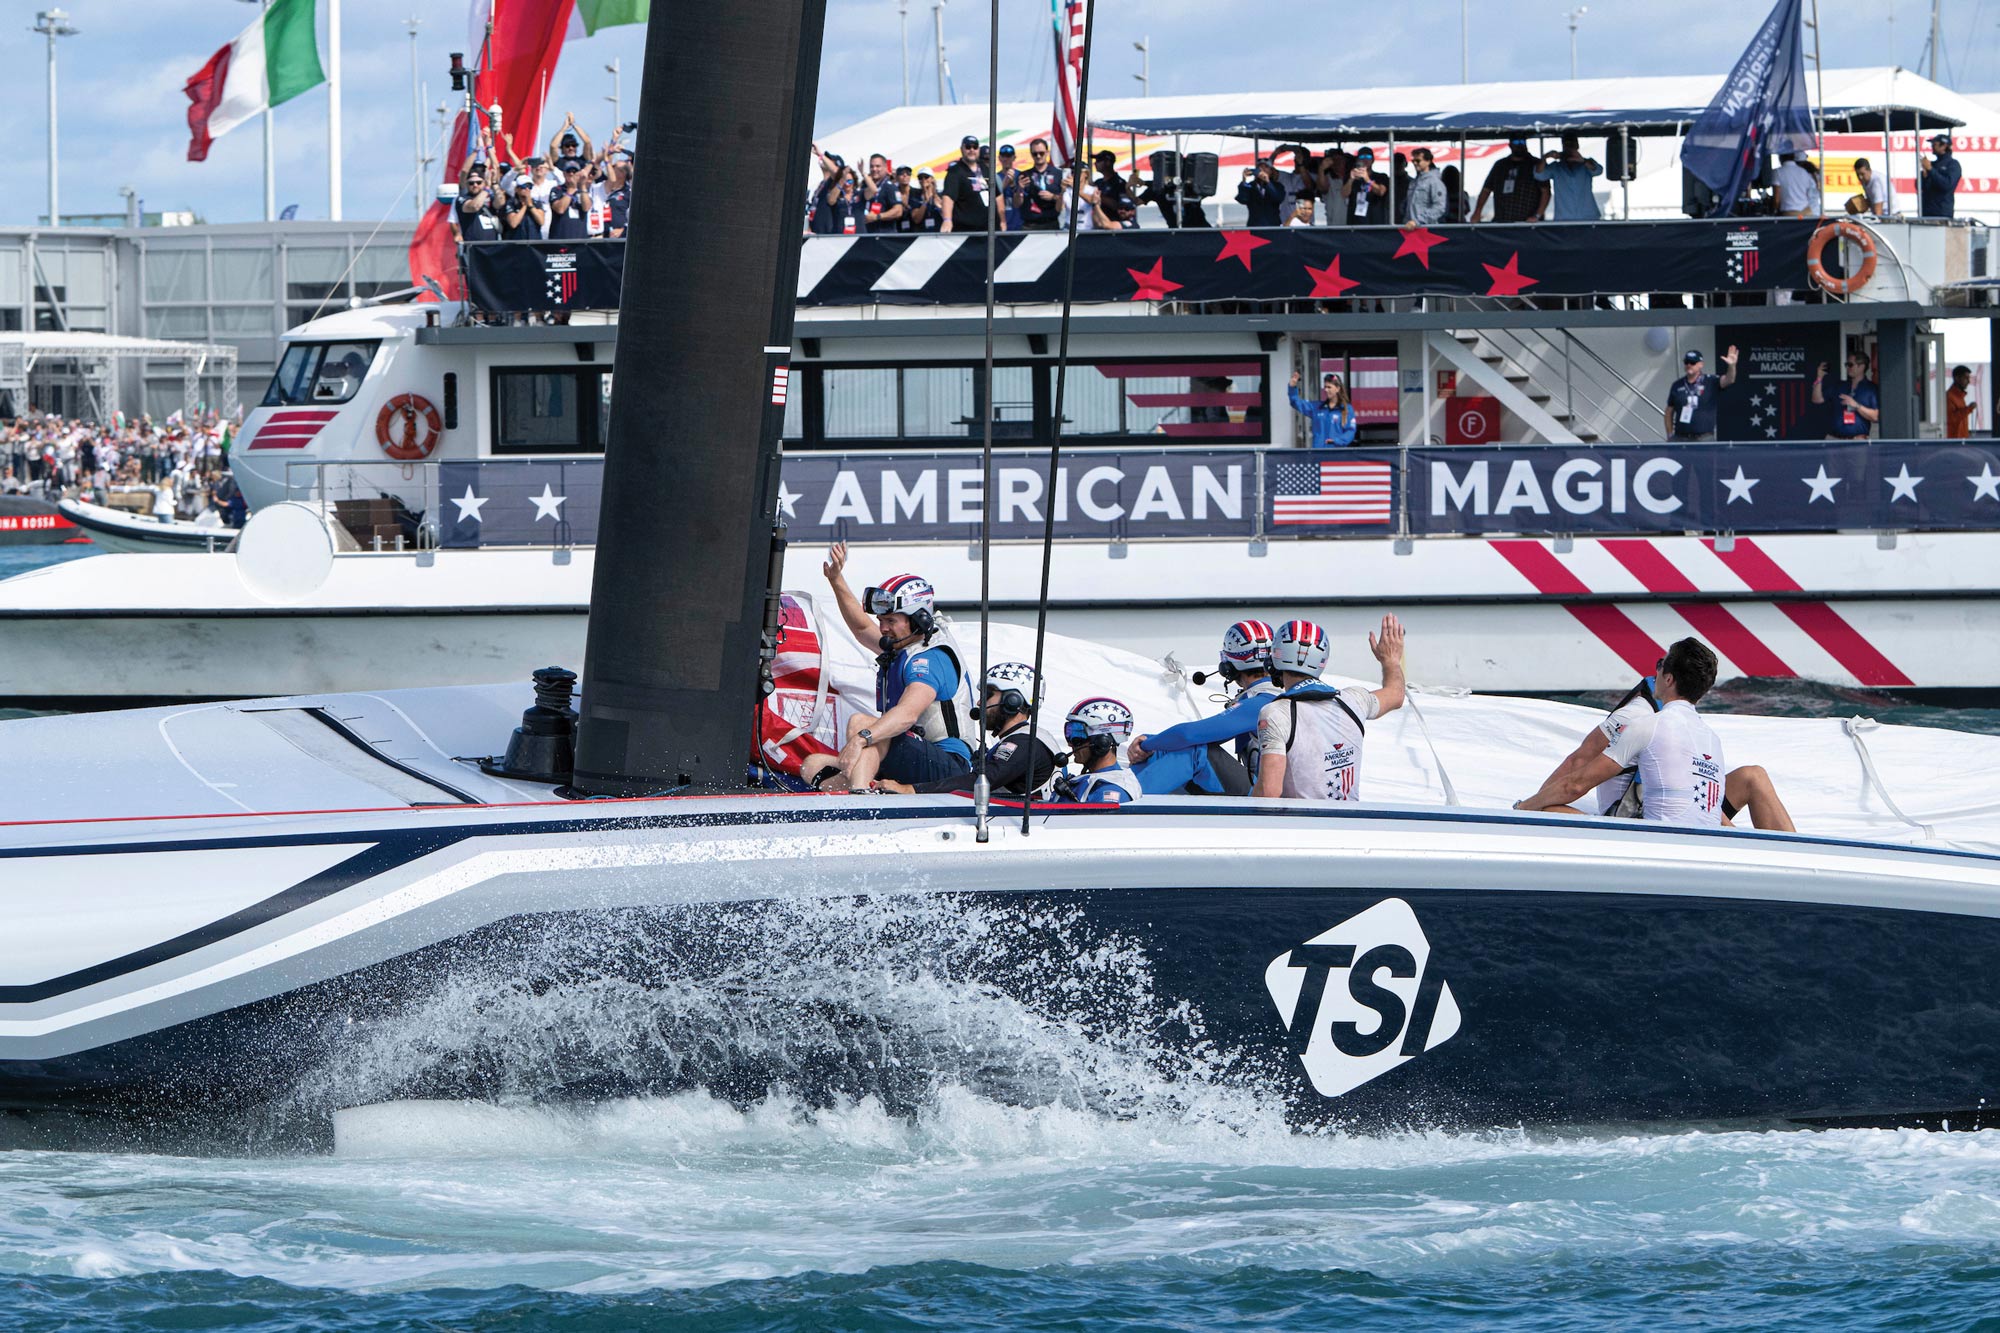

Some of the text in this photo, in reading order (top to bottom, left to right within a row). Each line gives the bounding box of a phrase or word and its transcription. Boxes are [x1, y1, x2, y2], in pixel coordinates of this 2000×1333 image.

[1750, 352, 1805, 361] AMERICAN
[1760, 362, 1796, 372] MAGIC
[1467, 416, 1477, 433] F
[819, 457, 1684, 525] AMERICAN MAGIC
[22, 516, 56, 529] ROSSA
[1324, 749, 1354, 761] AMERICAN
[1287, 943, 1450, 1058] TSI
